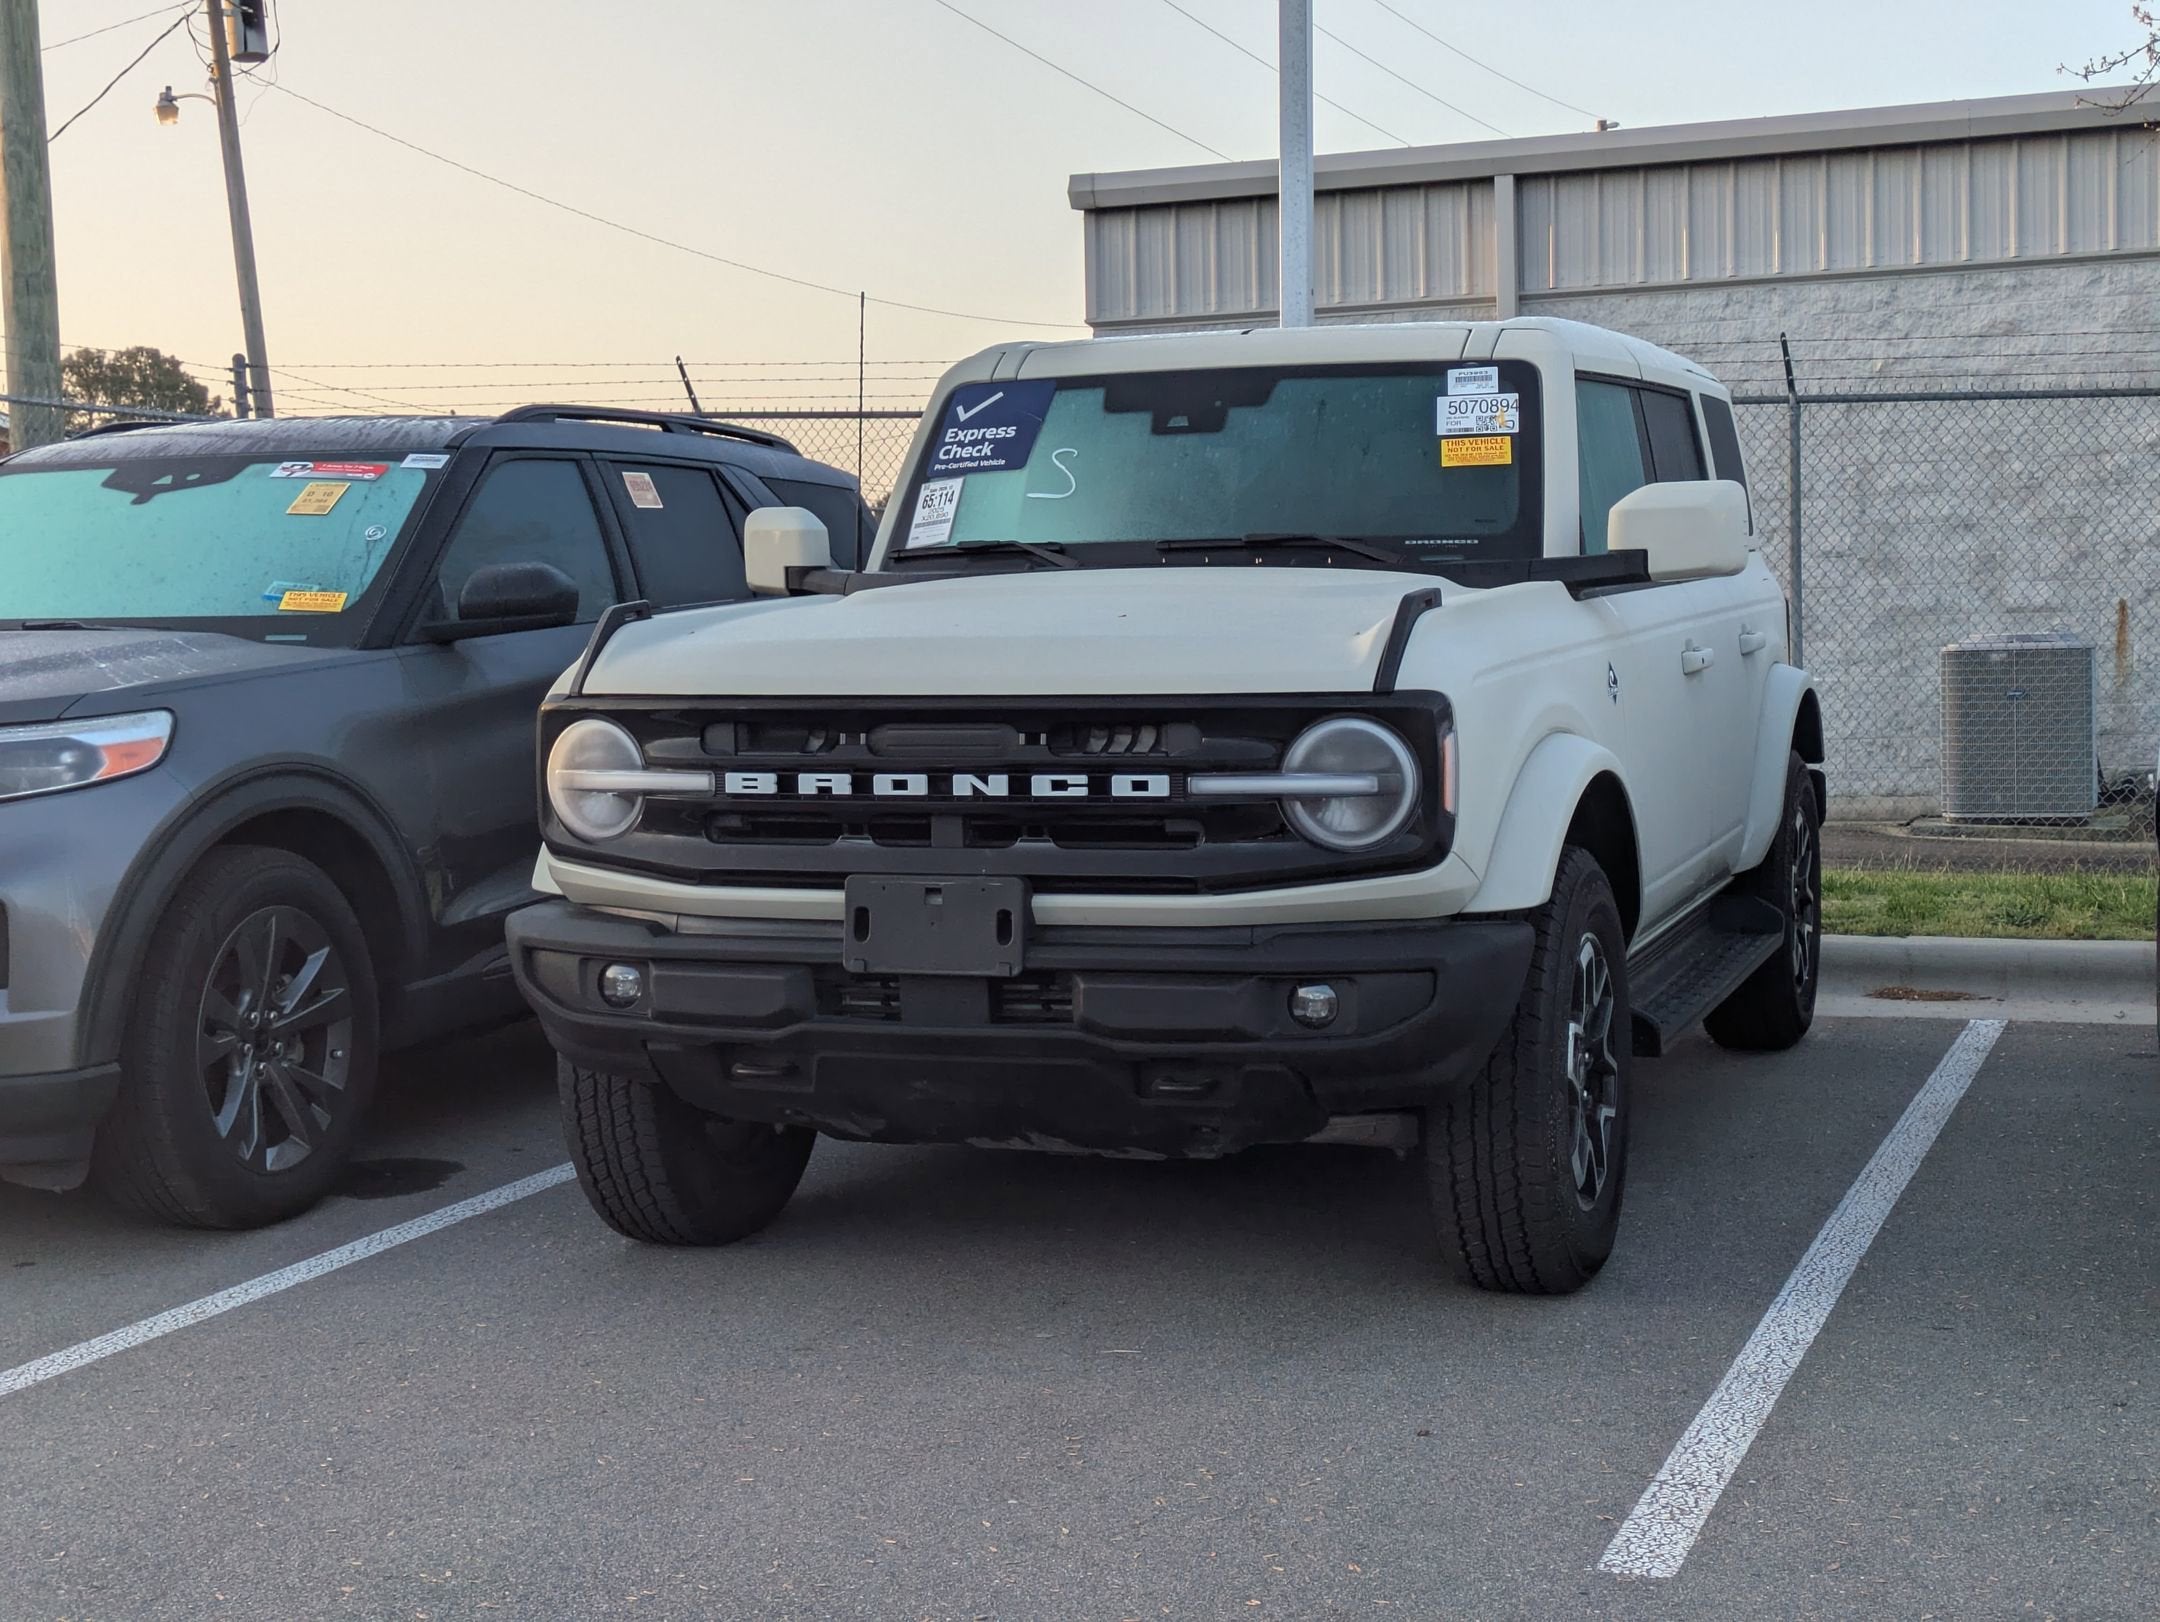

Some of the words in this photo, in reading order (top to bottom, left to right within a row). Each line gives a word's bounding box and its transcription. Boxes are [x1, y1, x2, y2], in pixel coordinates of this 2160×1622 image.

[1448, 398, 1519, 415] 5070894
[944, 426, 1017, 443] Express
[1468, 438, 1506, 446] VEHICLE
[939, 442, 995, 460] Check
[934, 460, 979, 471] Pre-Certified
[980, 458, 1006, 467] Vehicle
[922, 490, 955, 509] 65:114
[725, 772, 1170, 797] BRONCO
